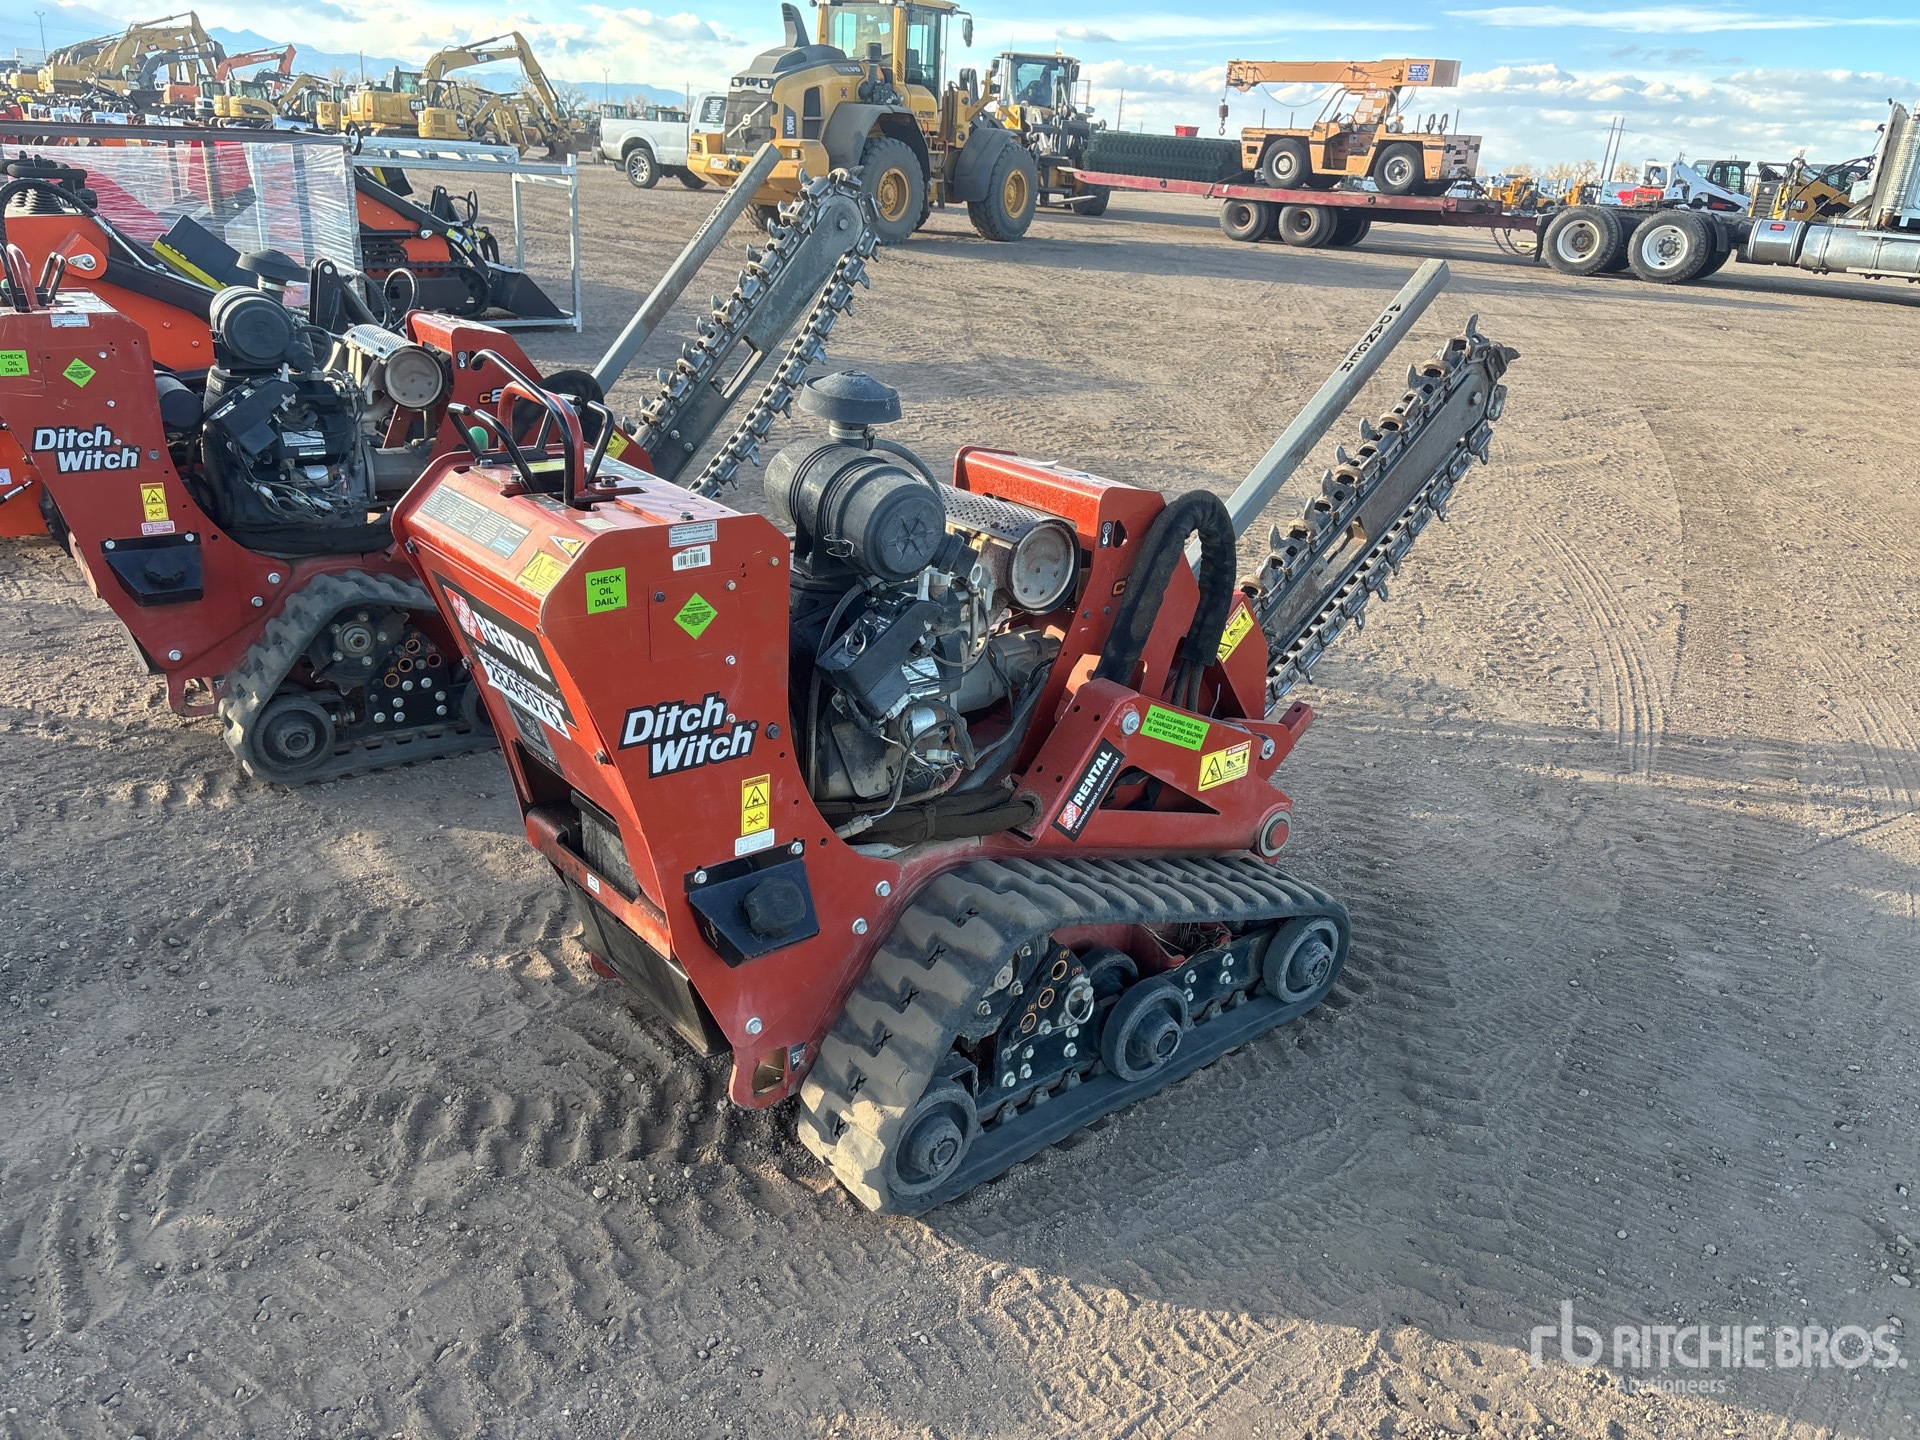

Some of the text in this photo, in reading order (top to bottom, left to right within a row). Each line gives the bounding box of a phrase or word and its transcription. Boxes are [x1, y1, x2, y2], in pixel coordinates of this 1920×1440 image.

[477, 54, 488, 62] CAT
[410, 101, 423, 110] CAT
[786, 116, 795, 135] L90H
[1790, 200, 1805, 211] CAT
[1339, 312, 1393, 373] DANGER
[34, 426, 112, 451] Ditch
[590, 574, 622, 587] CHECK
[599, 587, 614, 596] OIL
[594, 596, 620, 608] DAILY
[471, 610, 552, 683] RENTAL
[485, 661, 561, 727] 2846076
[623, 696, 726, 745] Ditch
[1152, 719, 1173, 730] CHARGED
[1186, 730, 1204, 740] MACHINE
[1165, 715, 1186, 727] CLEANING
[1162, 730, 1184, 741] RETURNED
[1183, 736, 1197, 745] CLEAN
[1073, 751, 1113, 807] RENTAL
[1075, 757, 1120, 830] homedepot.com/rental
